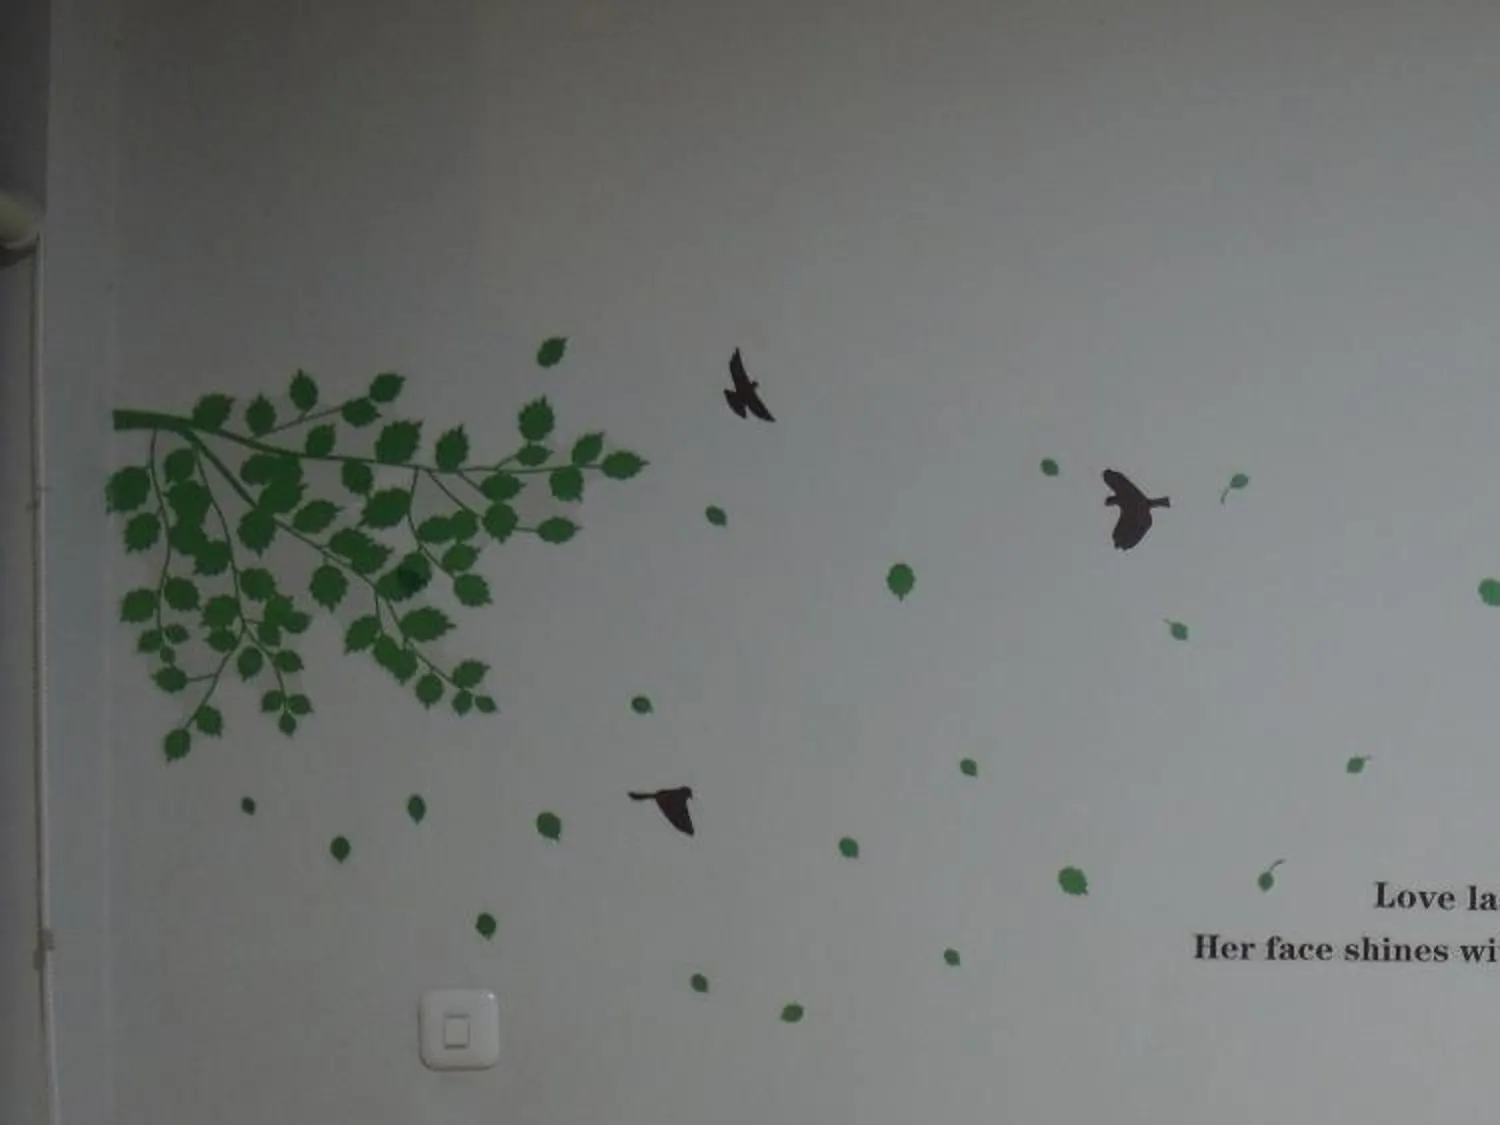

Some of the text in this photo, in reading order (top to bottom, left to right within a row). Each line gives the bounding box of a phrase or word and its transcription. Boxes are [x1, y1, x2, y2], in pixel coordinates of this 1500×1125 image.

[1375, 881, 1456, 911] Love
[1194, 933, 1257, 962] Her
[1266, 935, 1334, 962] face
[1344, 936, 1449, 964] shines
